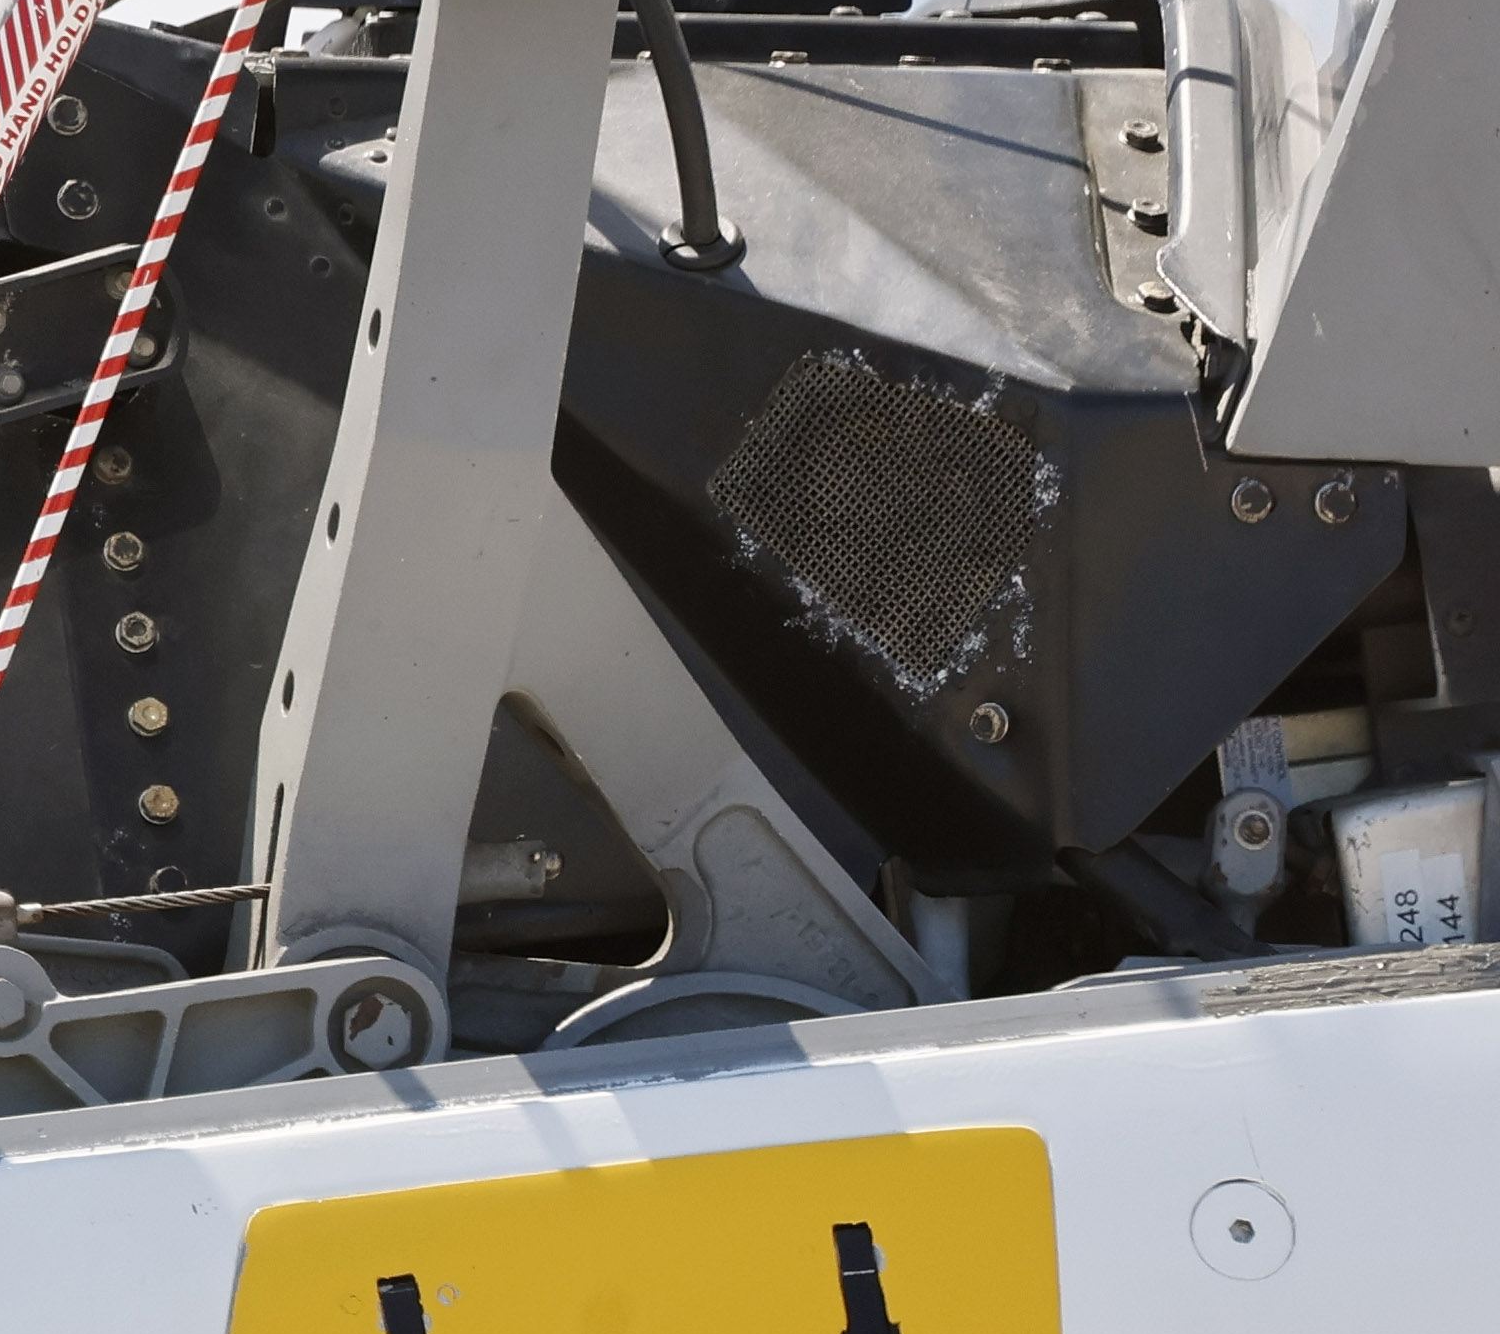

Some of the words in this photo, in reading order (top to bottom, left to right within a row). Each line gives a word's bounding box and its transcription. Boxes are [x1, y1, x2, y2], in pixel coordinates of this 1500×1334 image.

[0, 77, 47, 150] HAND
[44, 4, 89, 74] HOLD
[1394, 889, 1423, 943] 248
